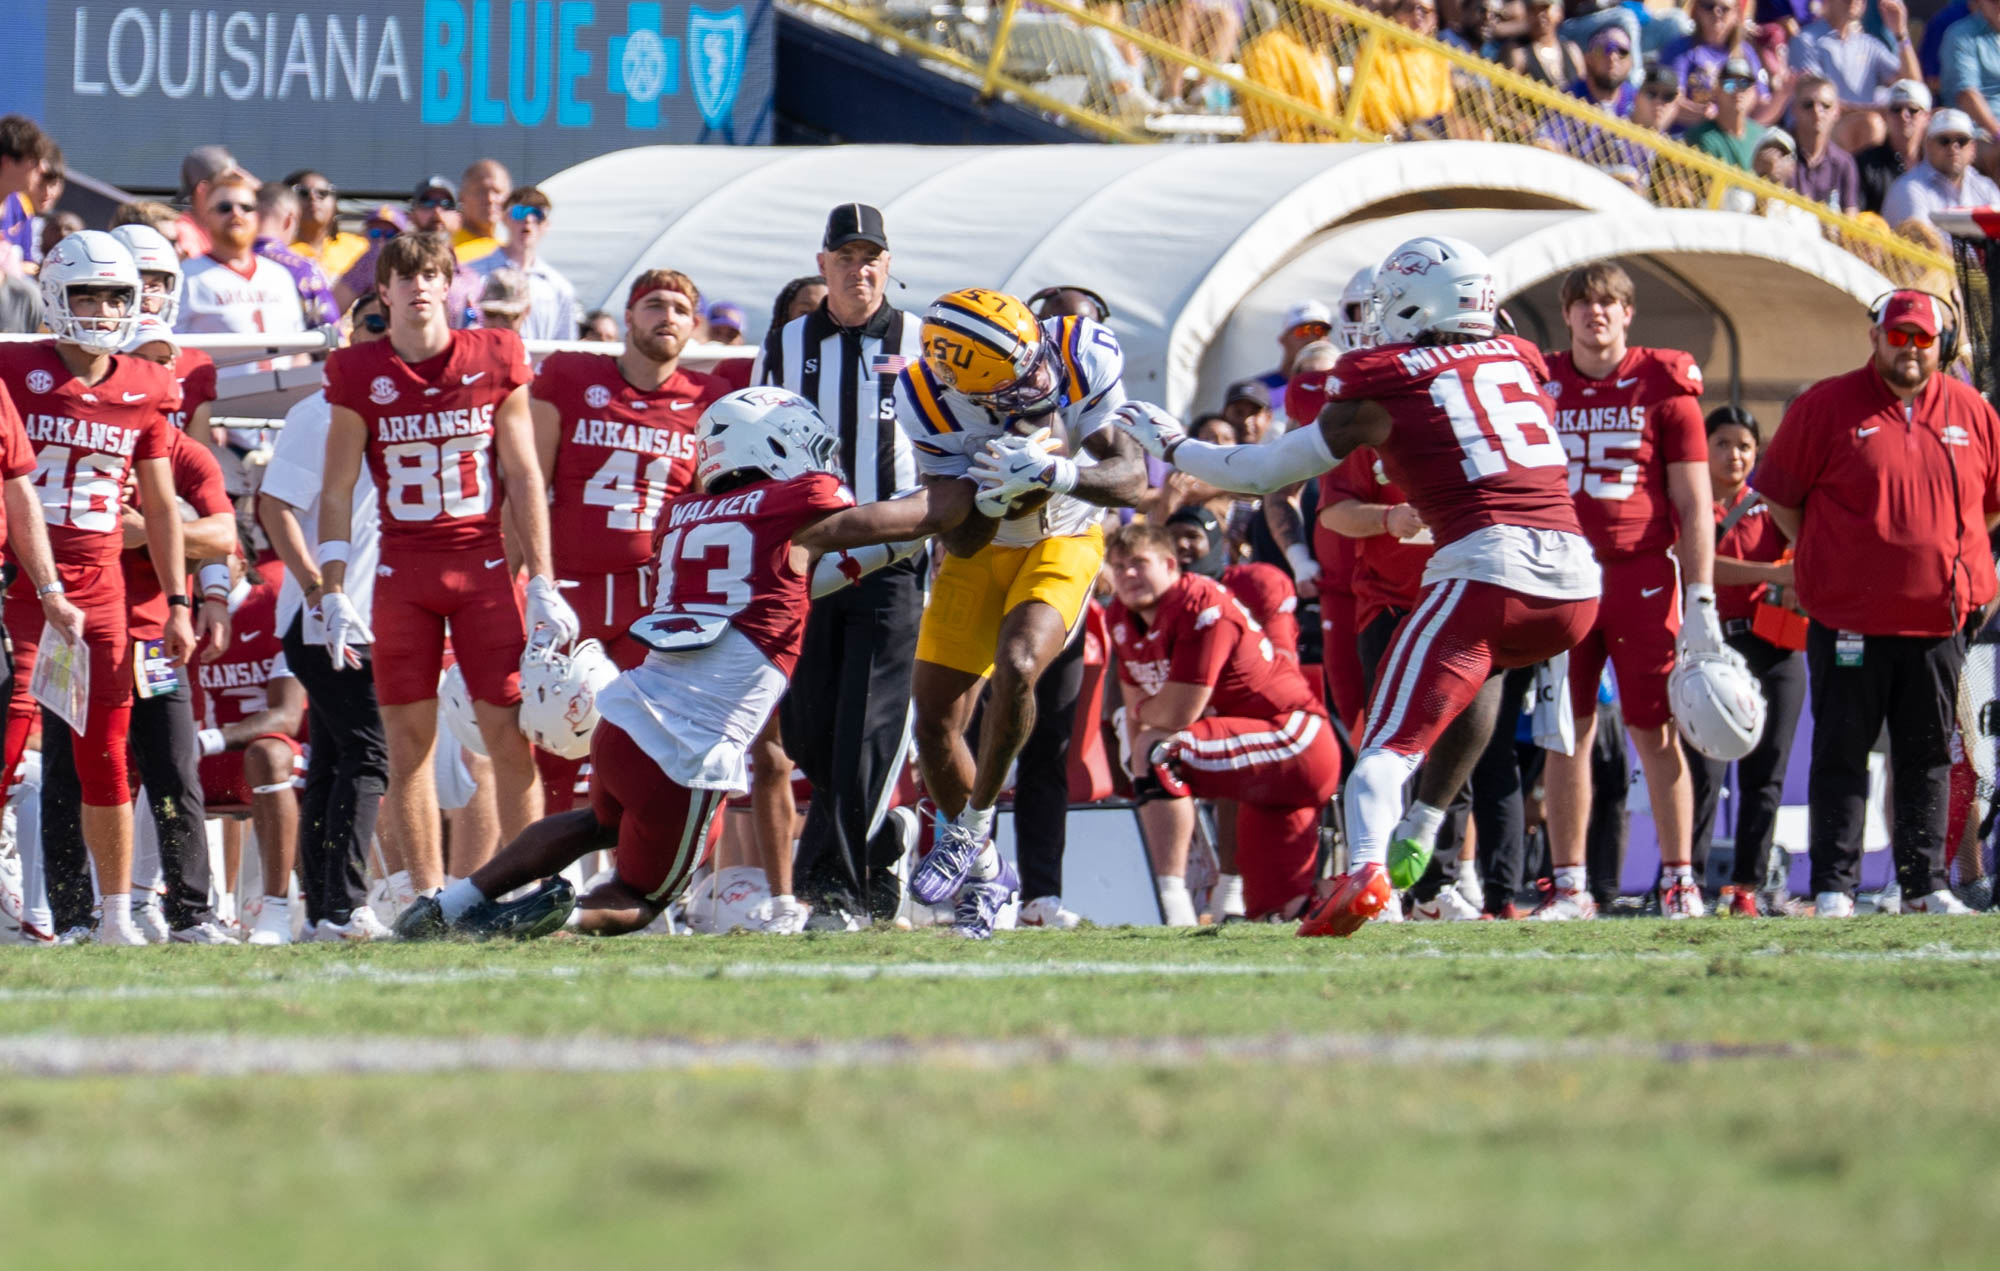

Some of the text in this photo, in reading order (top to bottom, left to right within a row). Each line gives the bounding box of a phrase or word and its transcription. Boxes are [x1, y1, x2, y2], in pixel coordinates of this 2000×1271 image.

[73, 0, 593, 126] LOUISIANA BLUE
[805, 358, 818, 374] S
[378, 403, 495, 442] ARKANSAS
[571, 418, 696, 460] ARKANSAS
[1428, 359, 1569, 482] 16
[1554, 405, 1645, 432] RKANSAS
[32, 444, 126, 533] 46
[382, 432, 493, 521] 80
[582, 449, 673, 531] 41
[668, 489, 765, 528] WALKER
[650, 520, 754, 617] 13
[198, 658, 273, 688] KANSAS
